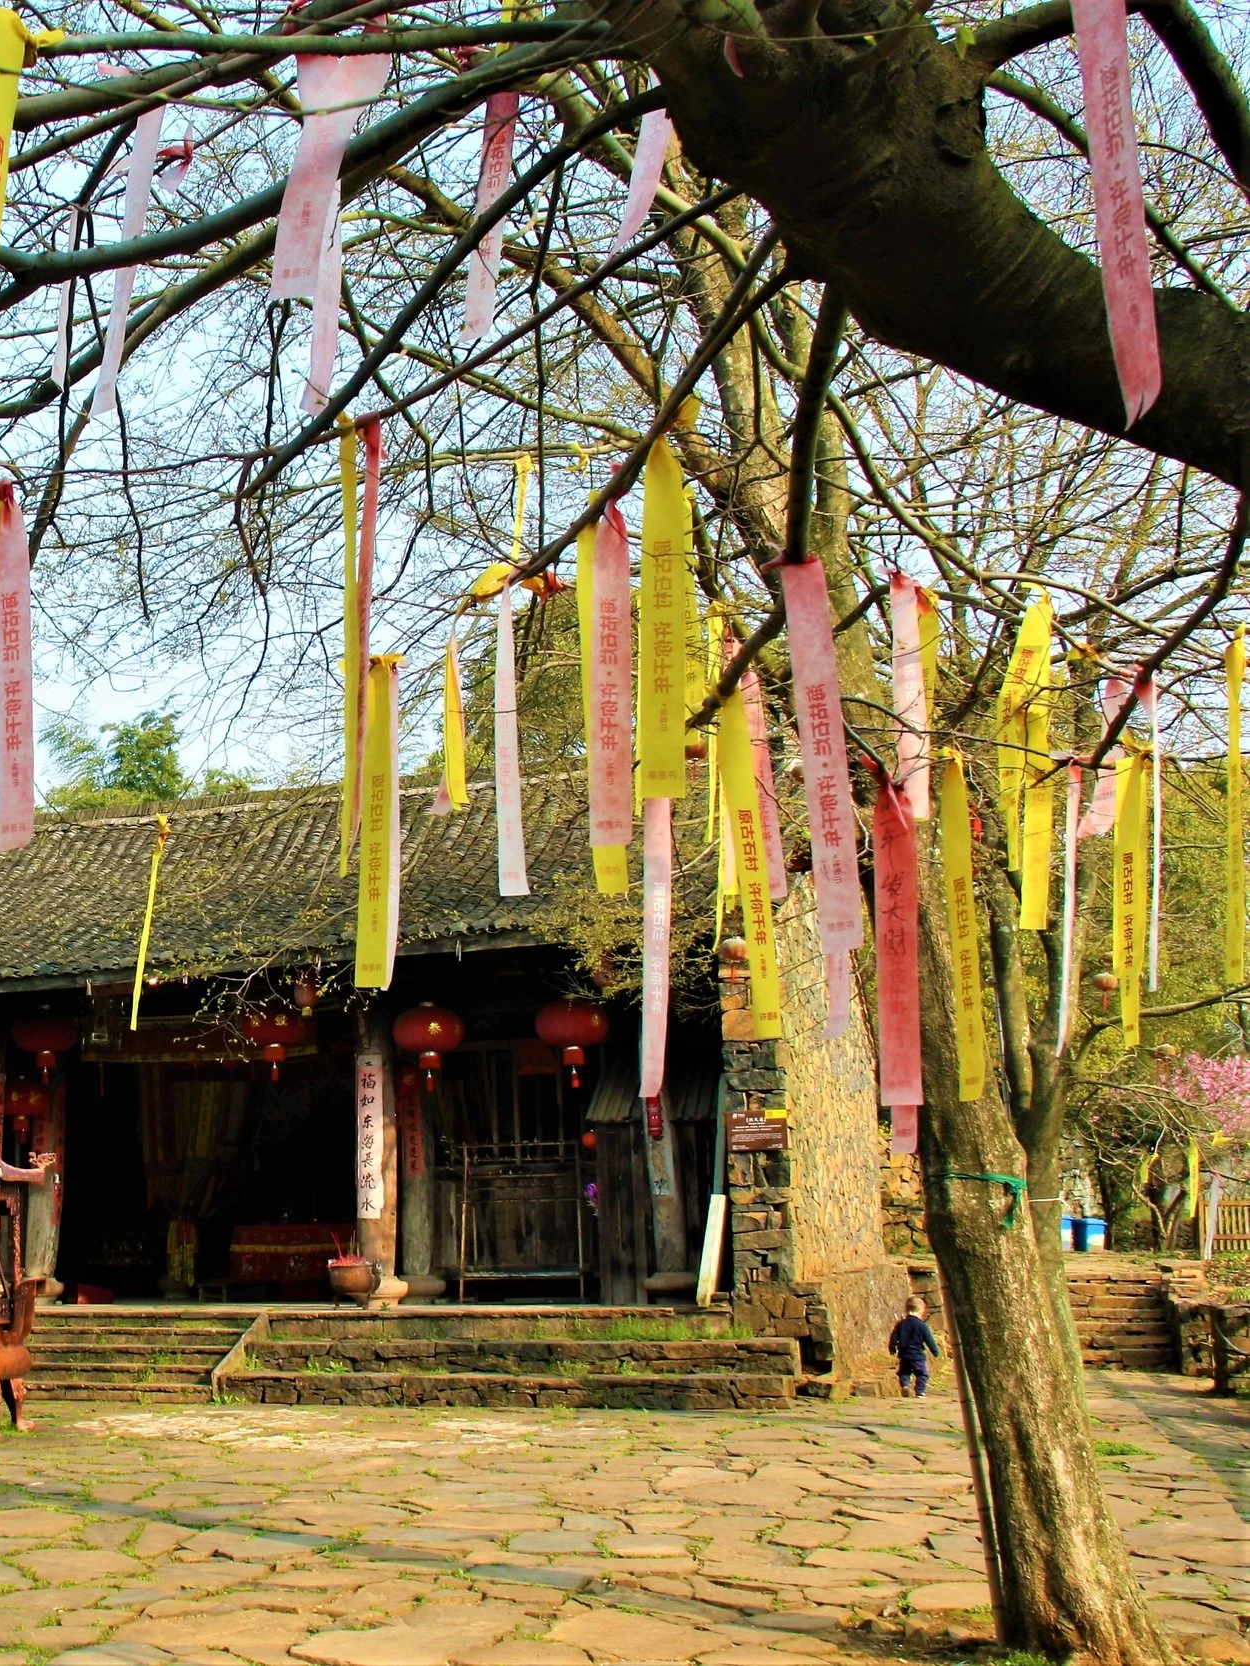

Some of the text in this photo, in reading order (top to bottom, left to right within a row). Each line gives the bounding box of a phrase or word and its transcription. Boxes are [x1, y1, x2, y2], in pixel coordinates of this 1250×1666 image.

[738, 809, 758, 872] 原古石村
[748, 882, 767, 946] 许你千年
[1123, 852, 1134, 905] 原古石村
[1123, 914, 1134, 968] 许你千年
